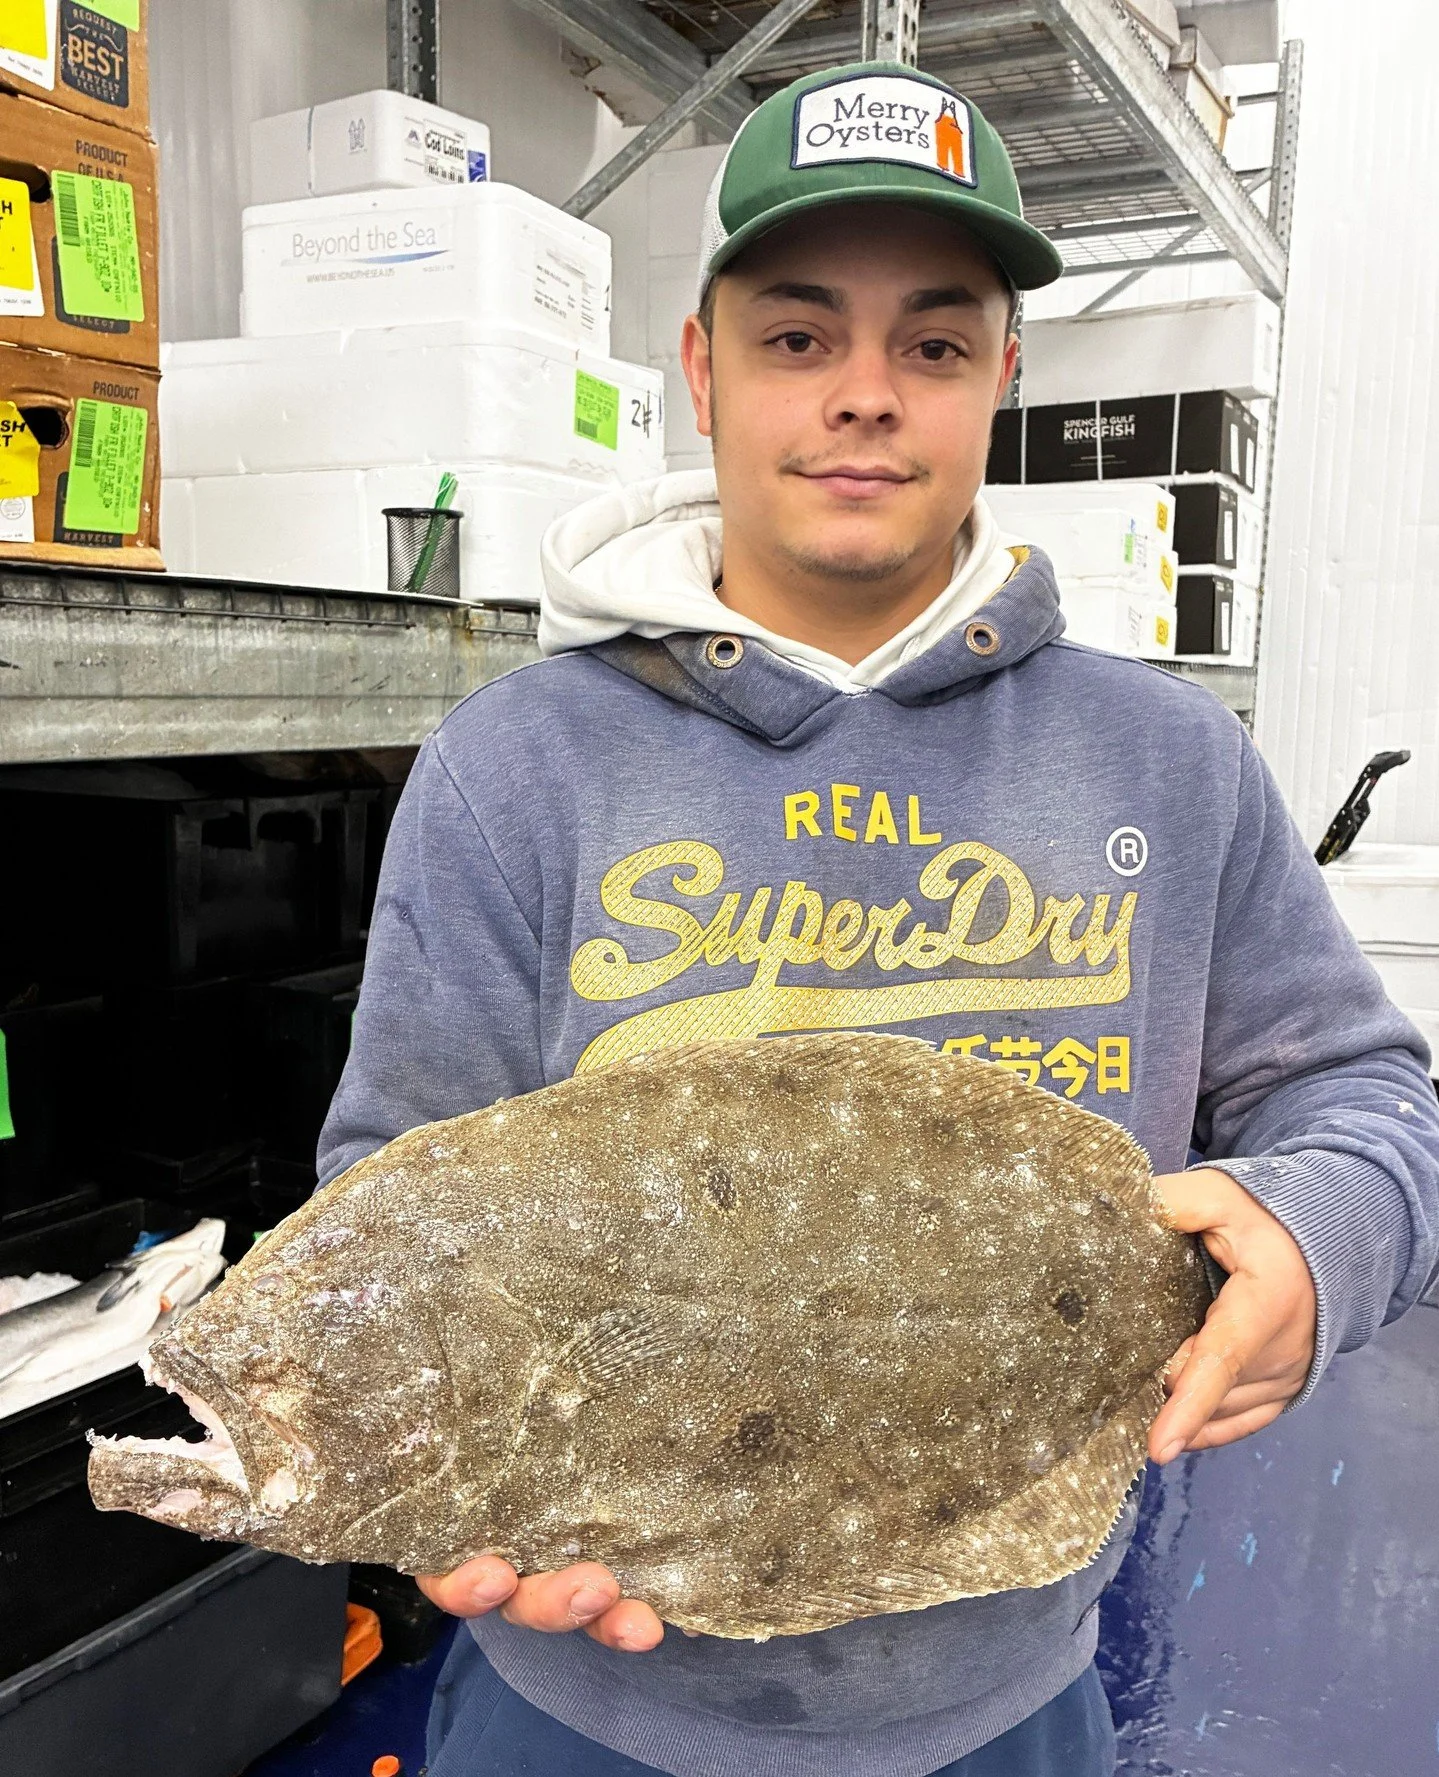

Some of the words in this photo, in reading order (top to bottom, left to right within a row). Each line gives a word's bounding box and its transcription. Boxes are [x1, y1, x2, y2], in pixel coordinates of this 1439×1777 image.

[68, 33, 124, 81] BEST
[834, 93, 930, 130] Merry
[806, 121, 930, 149] Oysters
[76, 139, 128, 168] PRODUCT
[292, 228, 360, 263] Beyond
[367, 225, 397, 251] the
[403, 221, 437, 248] Sea
[93, 380, 140, 401] PRODUCT
[1063, 416, 1107, 429] SPENCR
[1109, 414, 1136, 425] GULF
[1063, 422, 1136, 441] KINGFISH
[64, 531, 114, 544] HARVEST
[784, 783, 942, 846] REAL
